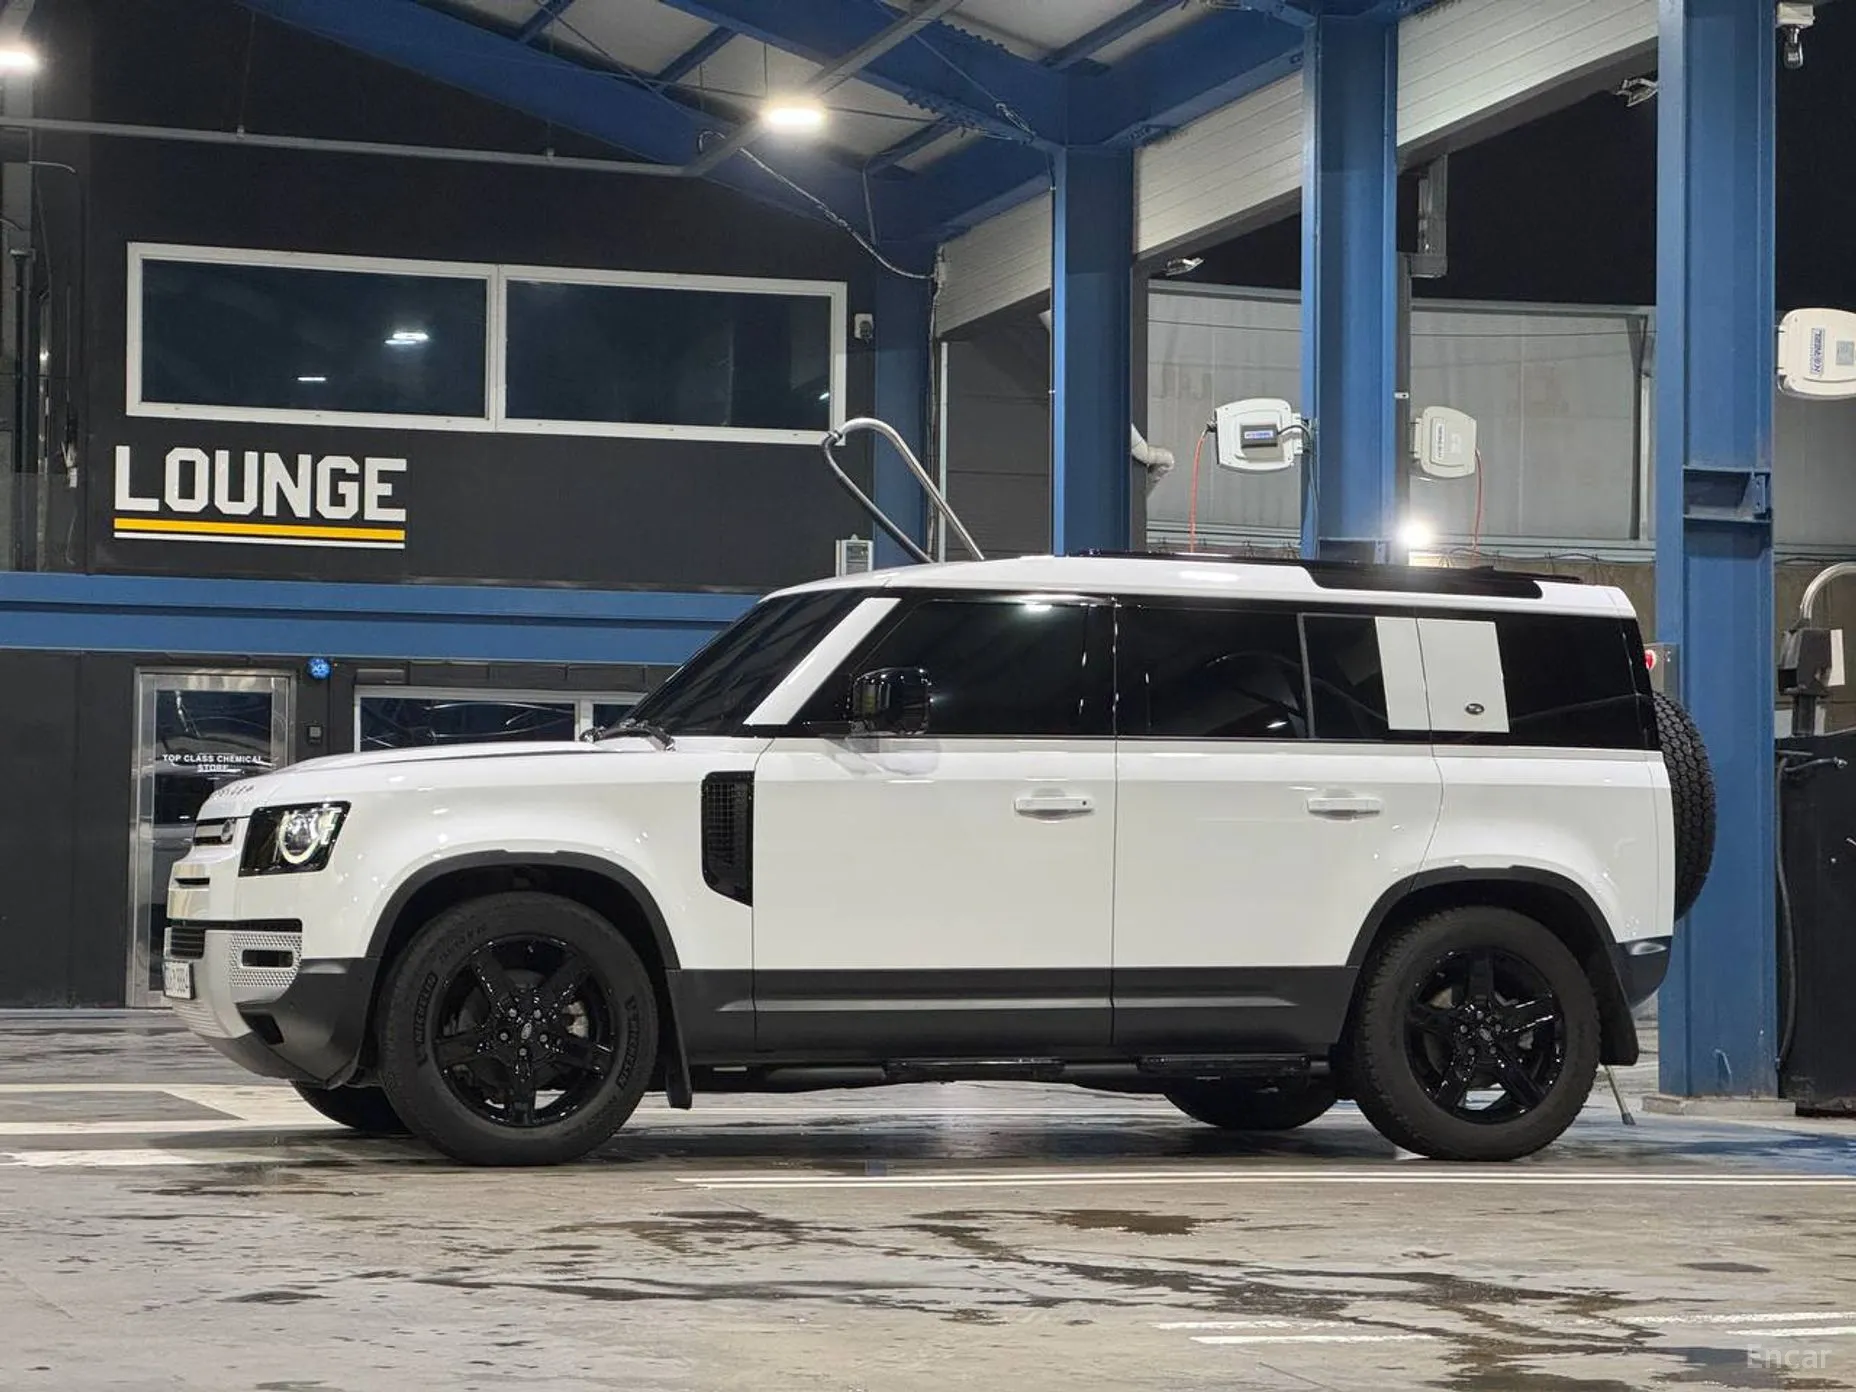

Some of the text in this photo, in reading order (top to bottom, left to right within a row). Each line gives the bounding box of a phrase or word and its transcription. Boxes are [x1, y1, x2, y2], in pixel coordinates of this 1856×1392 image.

[115, 445, 407, 522] LOUNGE
[162, 754, 262, 764] TOP CLASS CHEMICAL
[197, 764, 229, 773] STORE
